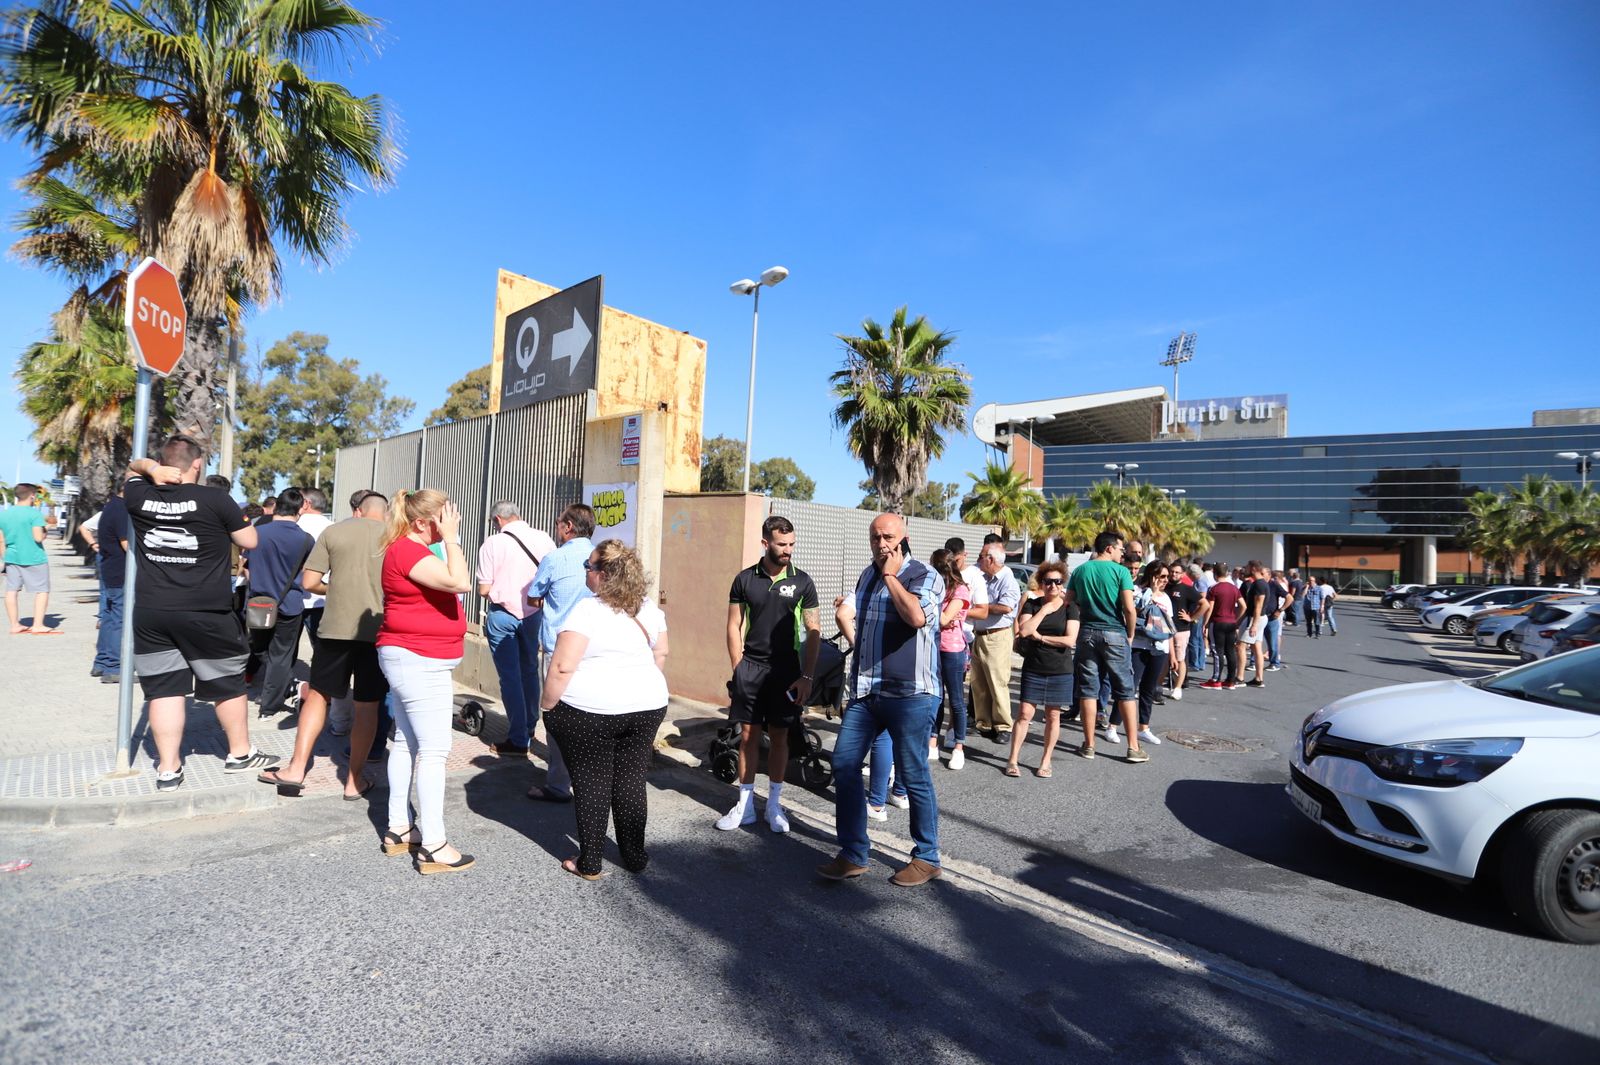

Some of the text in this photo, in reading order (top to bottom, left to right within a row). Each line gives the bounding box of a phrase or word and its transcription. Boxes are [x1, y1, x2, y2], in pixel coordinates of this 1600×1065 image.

[137, 296, 182, 338] STOP
[505, 372, 546, 397] LIQUID
[1160, 396, 1279, 434] Puerto Sur
[141, 499, 198, 514] RICARDO
